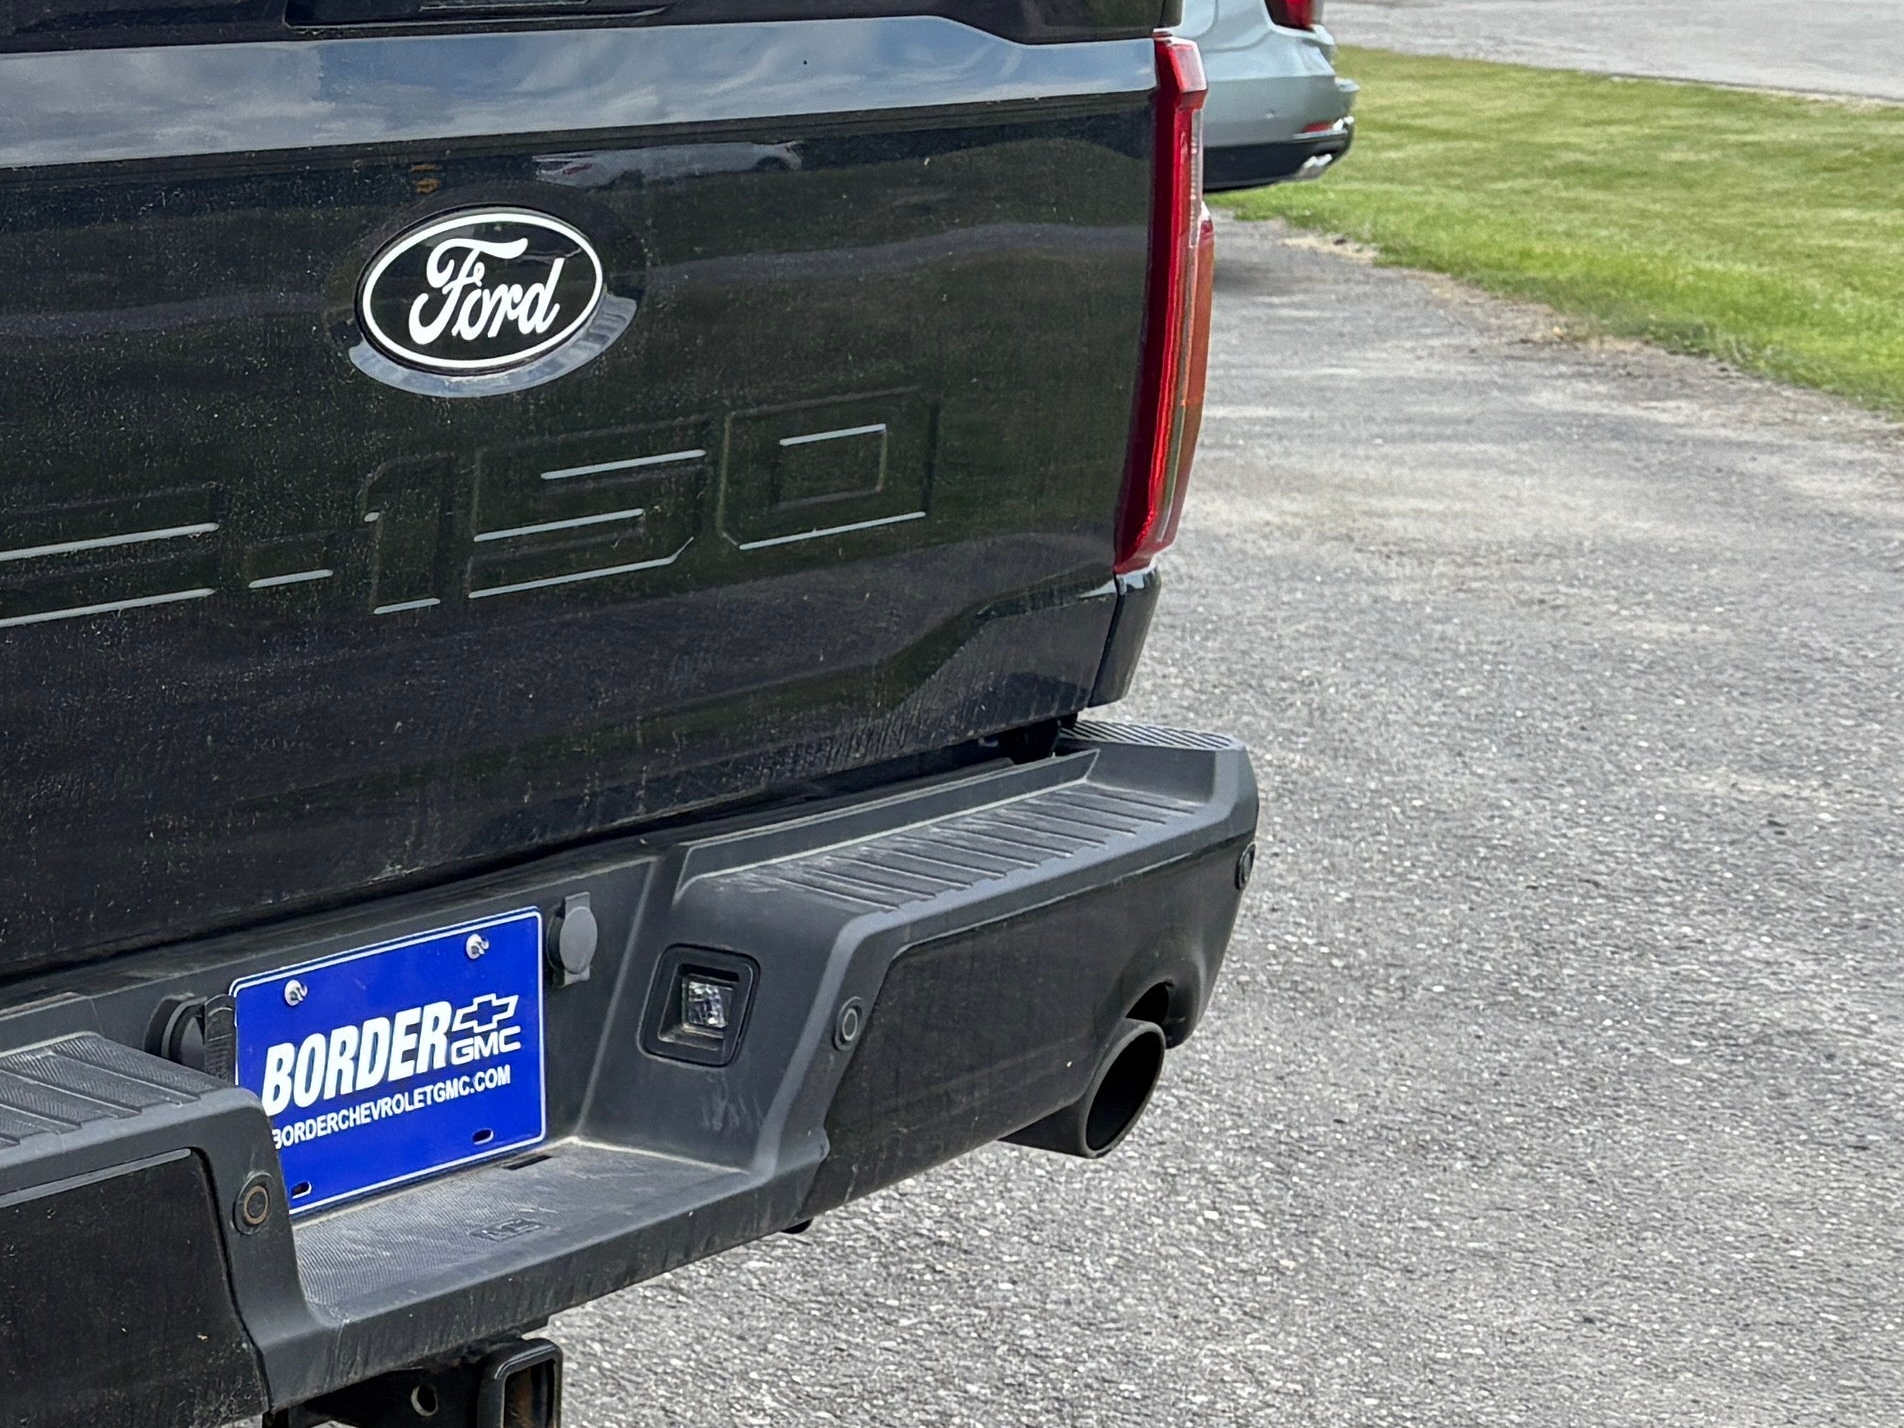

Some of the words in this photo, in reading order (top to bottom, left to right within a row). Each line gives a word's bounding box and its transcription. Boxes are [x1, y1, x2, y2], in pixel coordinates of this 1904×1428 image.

[408, 237, 566, 345] Ford
[260, 1001, 453, 1117] BORDER
[450, 1025, 522, 1066] GMC
[272, 1064, 511, 1150] BORDERCHEVROLETGMC.COM
